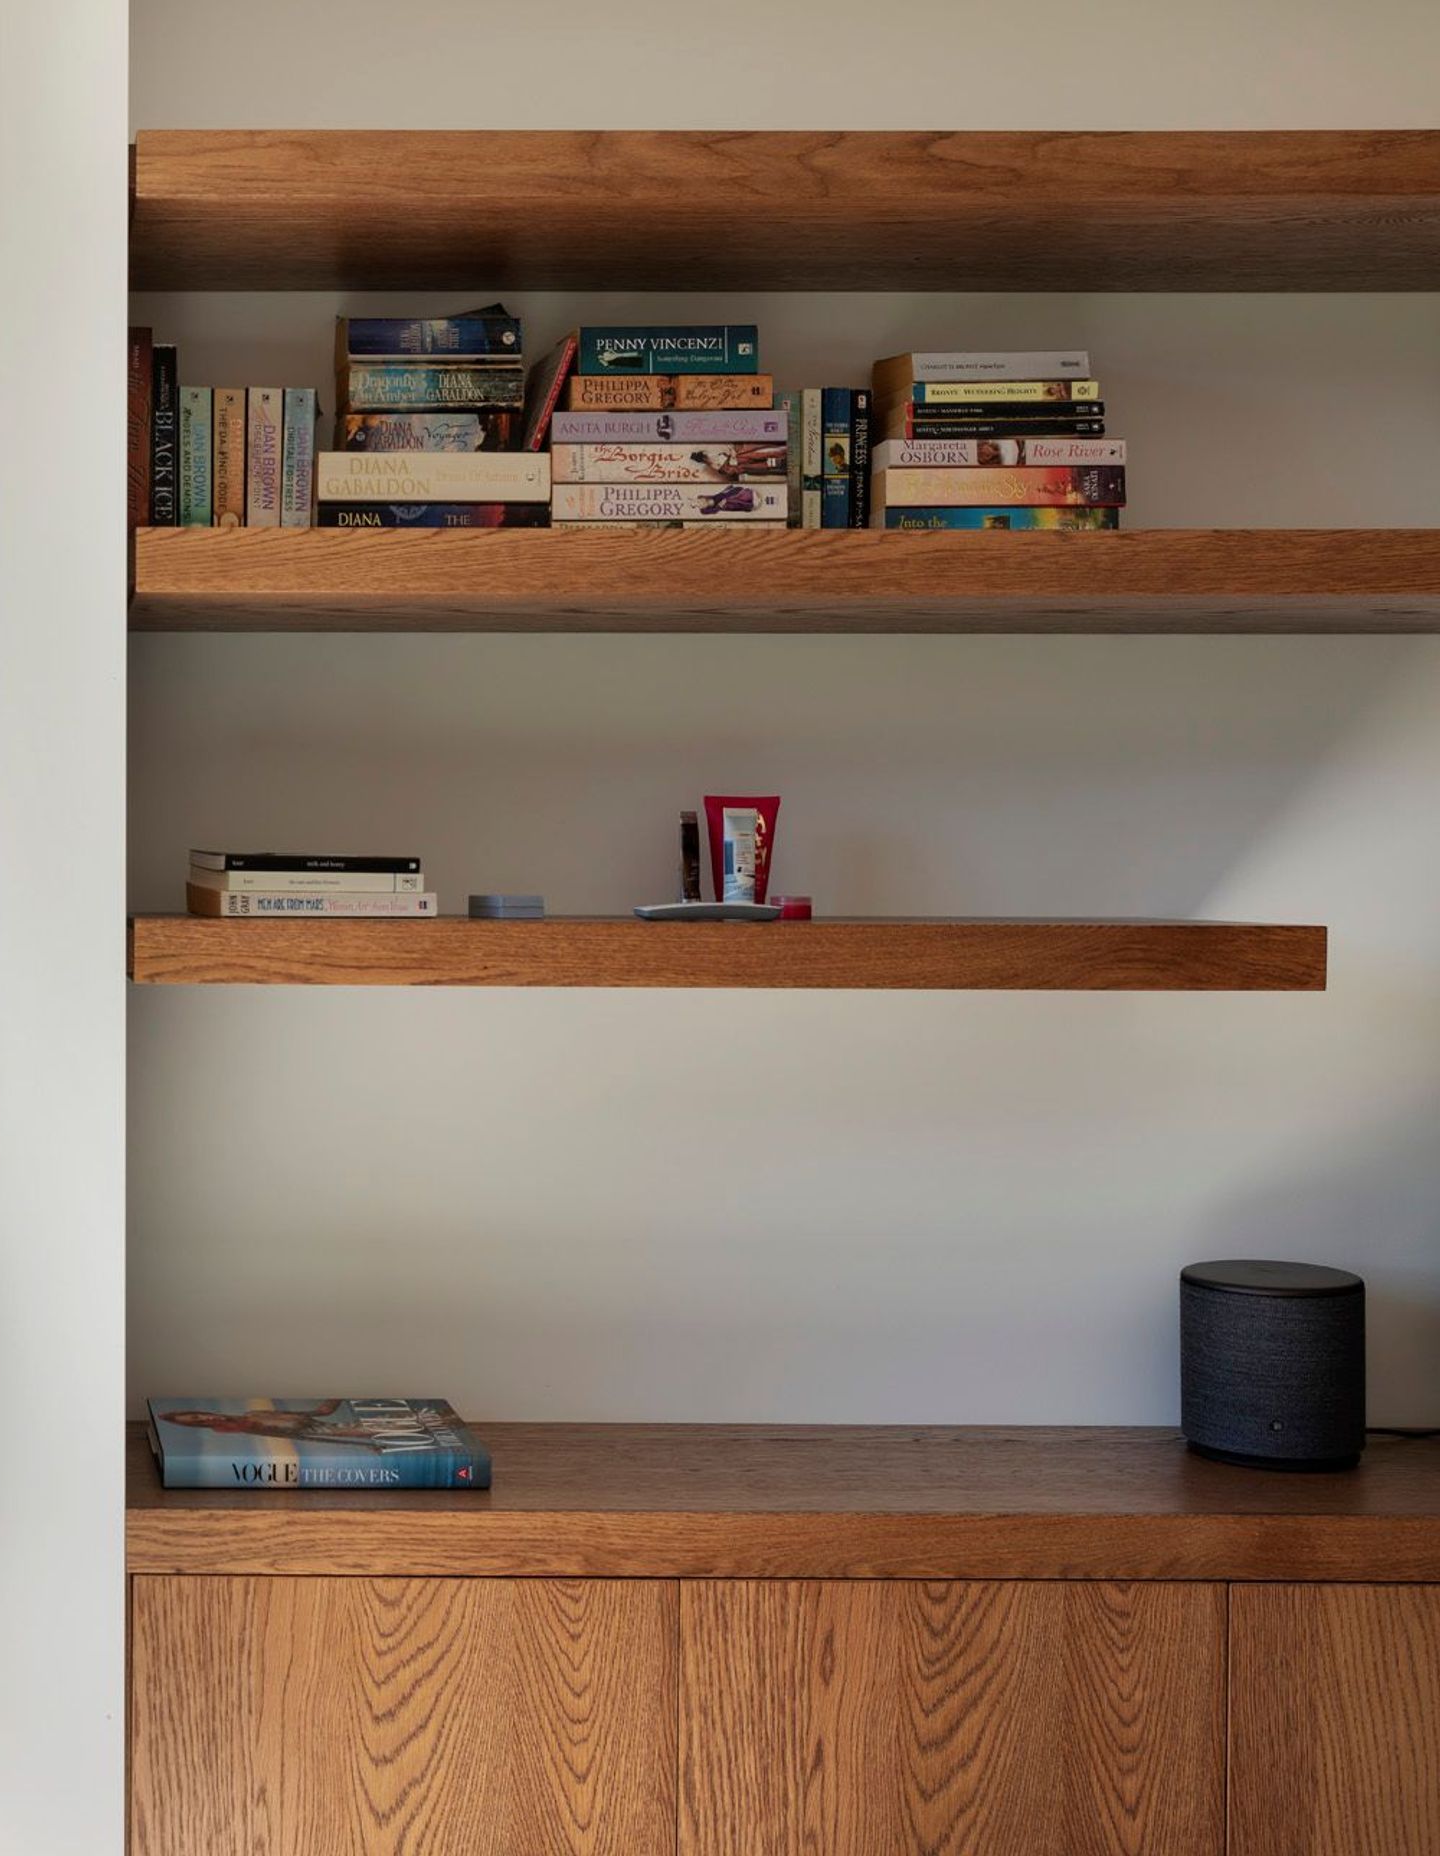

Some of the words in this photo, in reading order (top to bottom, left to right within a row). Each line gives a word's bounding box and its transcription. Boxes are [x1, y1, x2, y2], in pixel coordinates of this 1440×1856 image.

[596, 338, 647, 350] PENNY
[650, 337, 722, 350] VINCENZI
[357, 373, 417, 390] Dragonfly
[438, 374, 473, 388] DIANA
[583, 379, 650, 392] PHILIPPA
[377, 389, 417, 402] Amber
[426, 388, 485, 402] GABALDON
[581, 392, 652, 404] GREGORY
[184, 406, 192, 448] ANGELS
[219, 407, 228, 429] THE
[380, 420, 414, 434] DIANA
[560, 421, 601, 433] ANITA
[604, 421, 650, 433] BURGH
[194, 423, 206, 450] DAN
[219, 432, 227, 445] DA
[264, 424, 276, 454] DAN
[286, 426, 294, 462] DIGITAL
[298, 426, 309, 456] DAN
[855, 418, 868, 464] PRINCESS
[155, 410, 173, 482] BLACK
[1033, 444, 1063, 458] Rose
[1067, 444, 1106, 458] River
[184, 450, 192, 472] AND
[596, 446, 684, 467] Borgia
[900, 452, 968, 464] OSBORN
[349, 458, 410, 476] DIANA
[634, 465, 702, 481] Bride
[194, 455, 206, 508] BROWN
[262, 458, 275, 510] BROWN
[285, 464, 294, 512] FORTRESS
[296, 458, 308, 512] BROWN
[325, 478, 431, 496] GABALDON
[155, 486, 173, 520] ICE
[184, 474, 192, 520] DEMONS
[218, 482, 228, 512] CODE
[603, 488, 682, 501] PHILIPPA
[600, 501, 684, 516] GREGORY
[338, 512, 382, 527] DIANA
[446, 514, 472, 526] THE
[898, 516, 926, 528] Into
[927, 516, 948, 528] the
[229, 895, 238, 914] JOHN
[241, 895, 250, 914] GRAY
[258, 898, 272, 910] MEN
[273, 898, 285, 910] ARE
[287, 898, 305, 911] FROM
[232, 1463, 298, 1483] VOGUE
[304, 1468, 335, 1483] THE
[336, 1468, 399, 1484] COVERS
